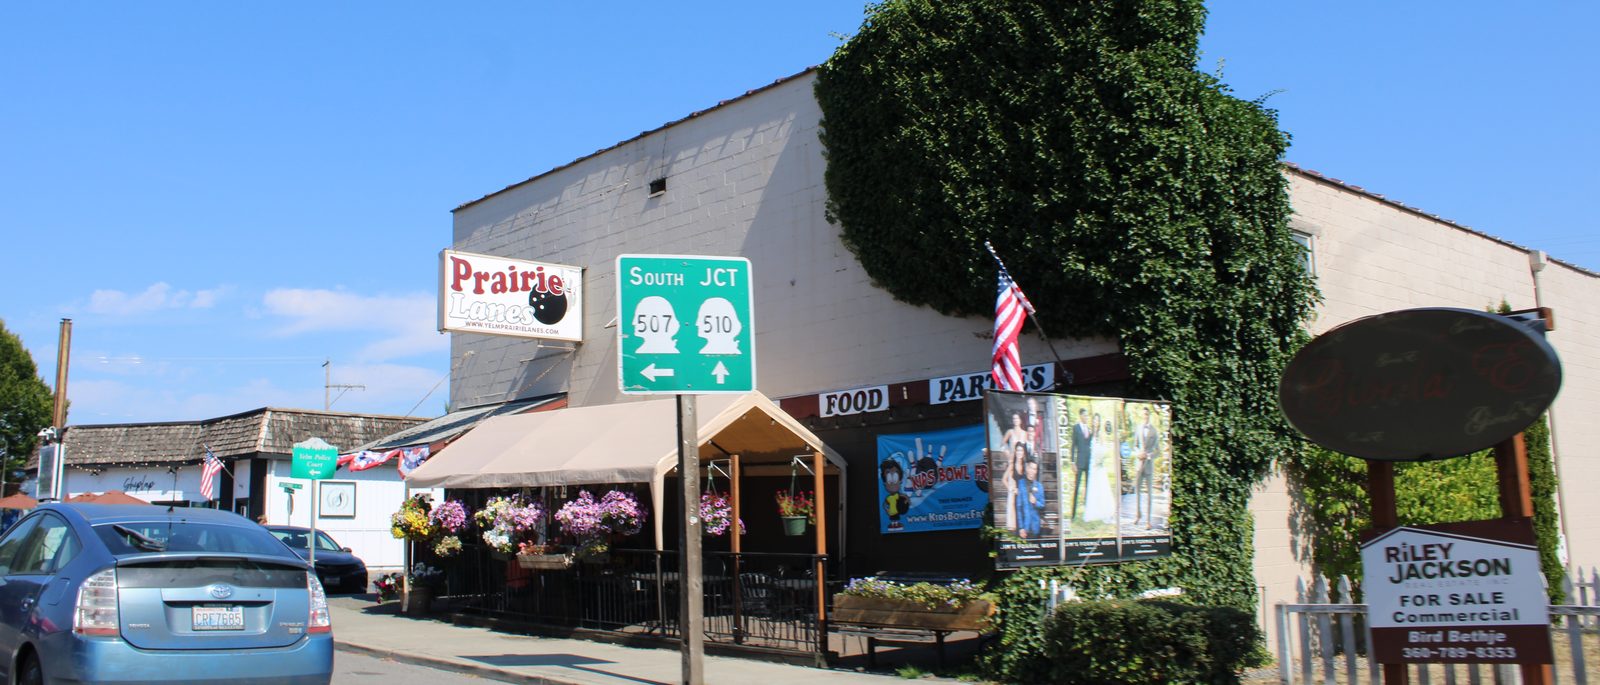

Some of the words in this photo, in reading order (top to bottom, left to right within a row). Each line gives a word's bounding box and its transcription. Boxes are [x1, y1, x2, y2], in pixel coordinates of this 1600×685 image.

[450, 255, 564, 295] Prairie
[700, 268, 738, 287] JCT
[449, 292, 536, 326] Lanes
[637, 314, 672, 333] 507
[703, 315, 733, 334] 510
[938, 366, 1045, 401] PARTES
[825, 388, 883, 415] FOOD
[1056, 398, 1069, 467] MICHAEL
[911, 469, 936, 490] KIDS
[938, 464, 971, 482] BOWL
[1389, 558, 1513, 584] JACKSON
[1400, 594, 1441, 607] FOR
[1448, 592, 1506, 606] SALE
[1392, 608, 1520, 623] Commercial
[1408, 630, 1443, 643] Bird
[1447, 630, 1507, 645] Bethje
